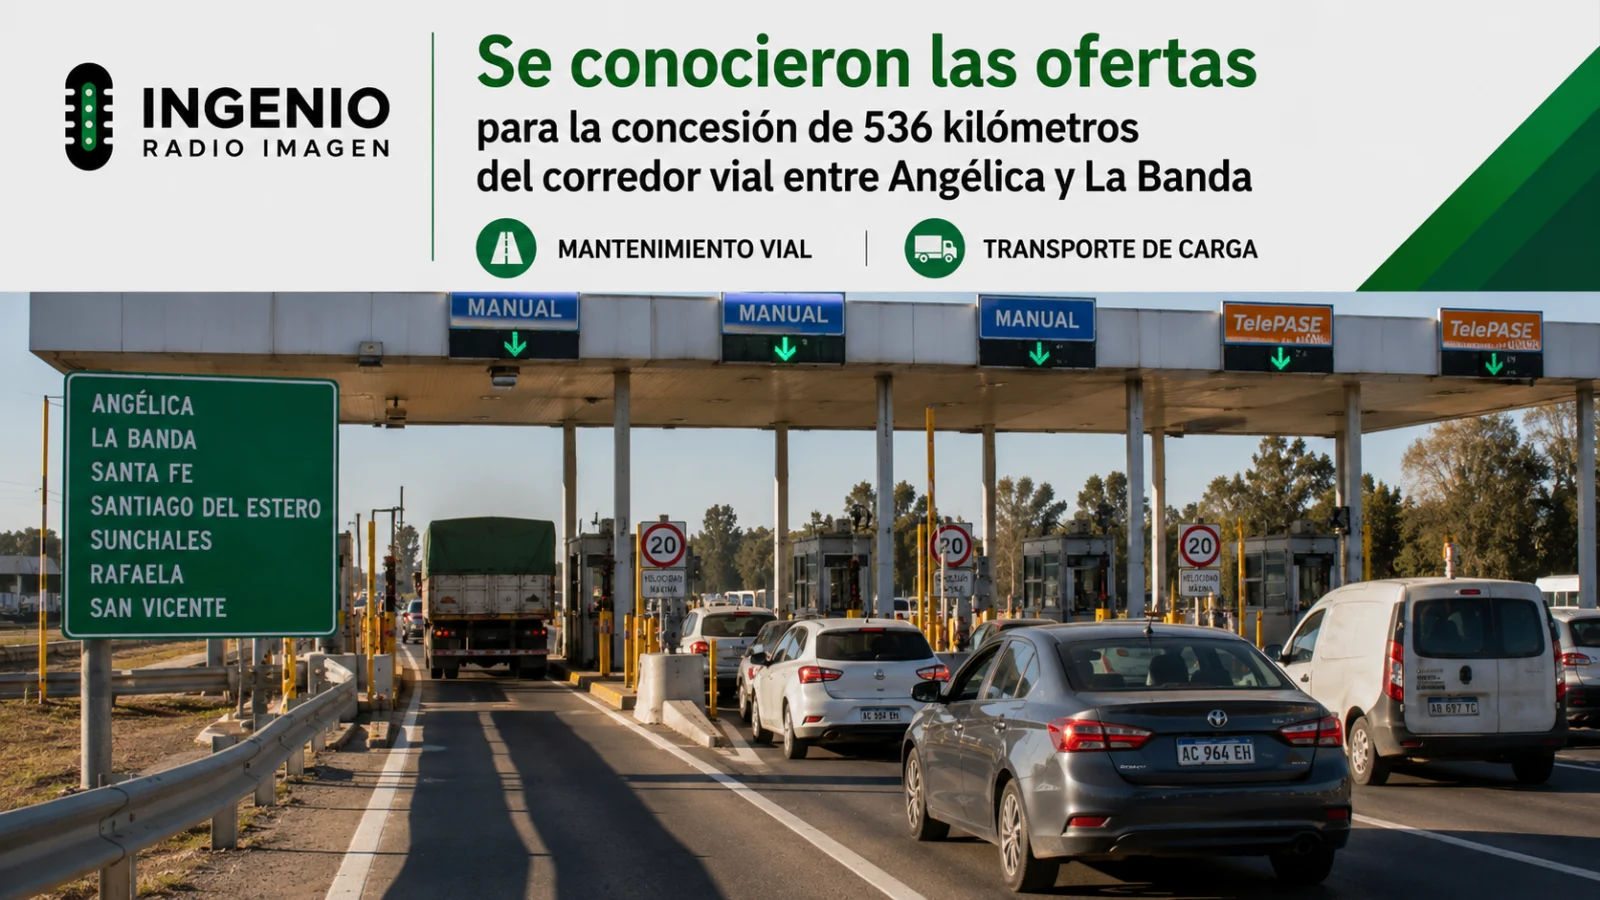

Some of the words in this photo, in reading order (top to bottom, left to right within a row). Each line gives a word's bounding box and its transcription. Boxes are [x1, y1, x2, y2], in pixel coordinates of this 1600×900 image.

[468, 298, 562, 318] MANUAL
[738, 304, 829, 324] MANUAL
[995, 309, 1080, 329] MANUAL
[1233, 313, 1323, 333] TelePASE
[1450, 319, 1534, 339] TelePASE
[92, 390, 194, 416] ANGÉLICA
[92, 427, 118, 448] LA
[128, 428, 197, 450] BANDA
[91, 462, 159, 482] SANTA
[169, 463, 193, 483] FE
[91, 496, 193, 517] SANTIAGO
[203, 498, 239, 517] DEL
[247, 498, 321, 518] ESTERO
[91, 530, 212, 550] SUNCHALES
[651, 536, 676, 554] 20
[1189, 537, 1212, 555] 20
[91, 564, 184, 584] RAFAELA
[91, 598, 131, 618] SAN
[142, 598, 227, 618] VICENTE
[1182, 746, 1199, 761] AC
[1203, 745, 1229, 761] 964
[1234, 745, 1251, 760] EH
